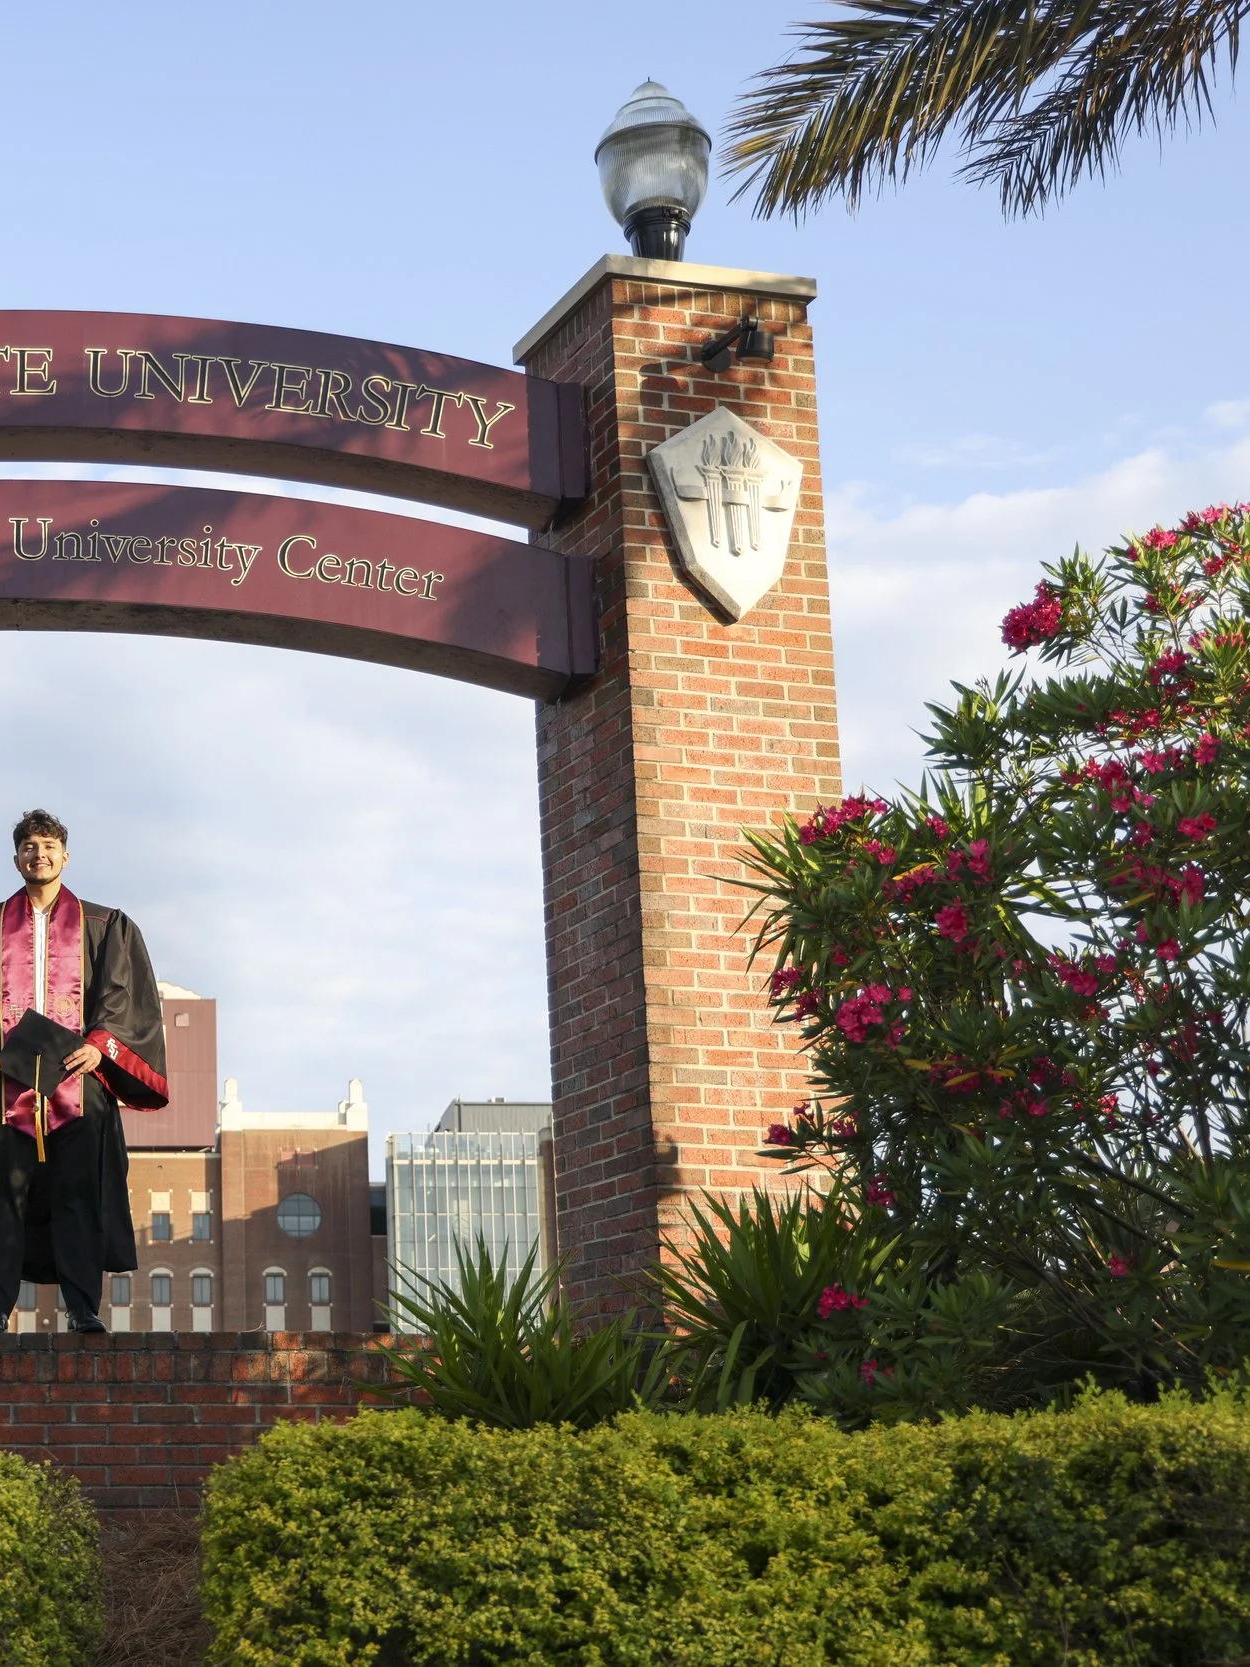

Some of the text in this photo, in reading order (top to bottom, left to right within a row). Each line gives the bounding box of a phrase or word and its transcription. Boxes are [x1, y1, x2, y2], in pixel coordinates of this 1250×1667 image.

[84, 347, 516, 450] UNIVERSITY
[9, 516, 263, 587] University
[277, 535, 445, 601] Center
